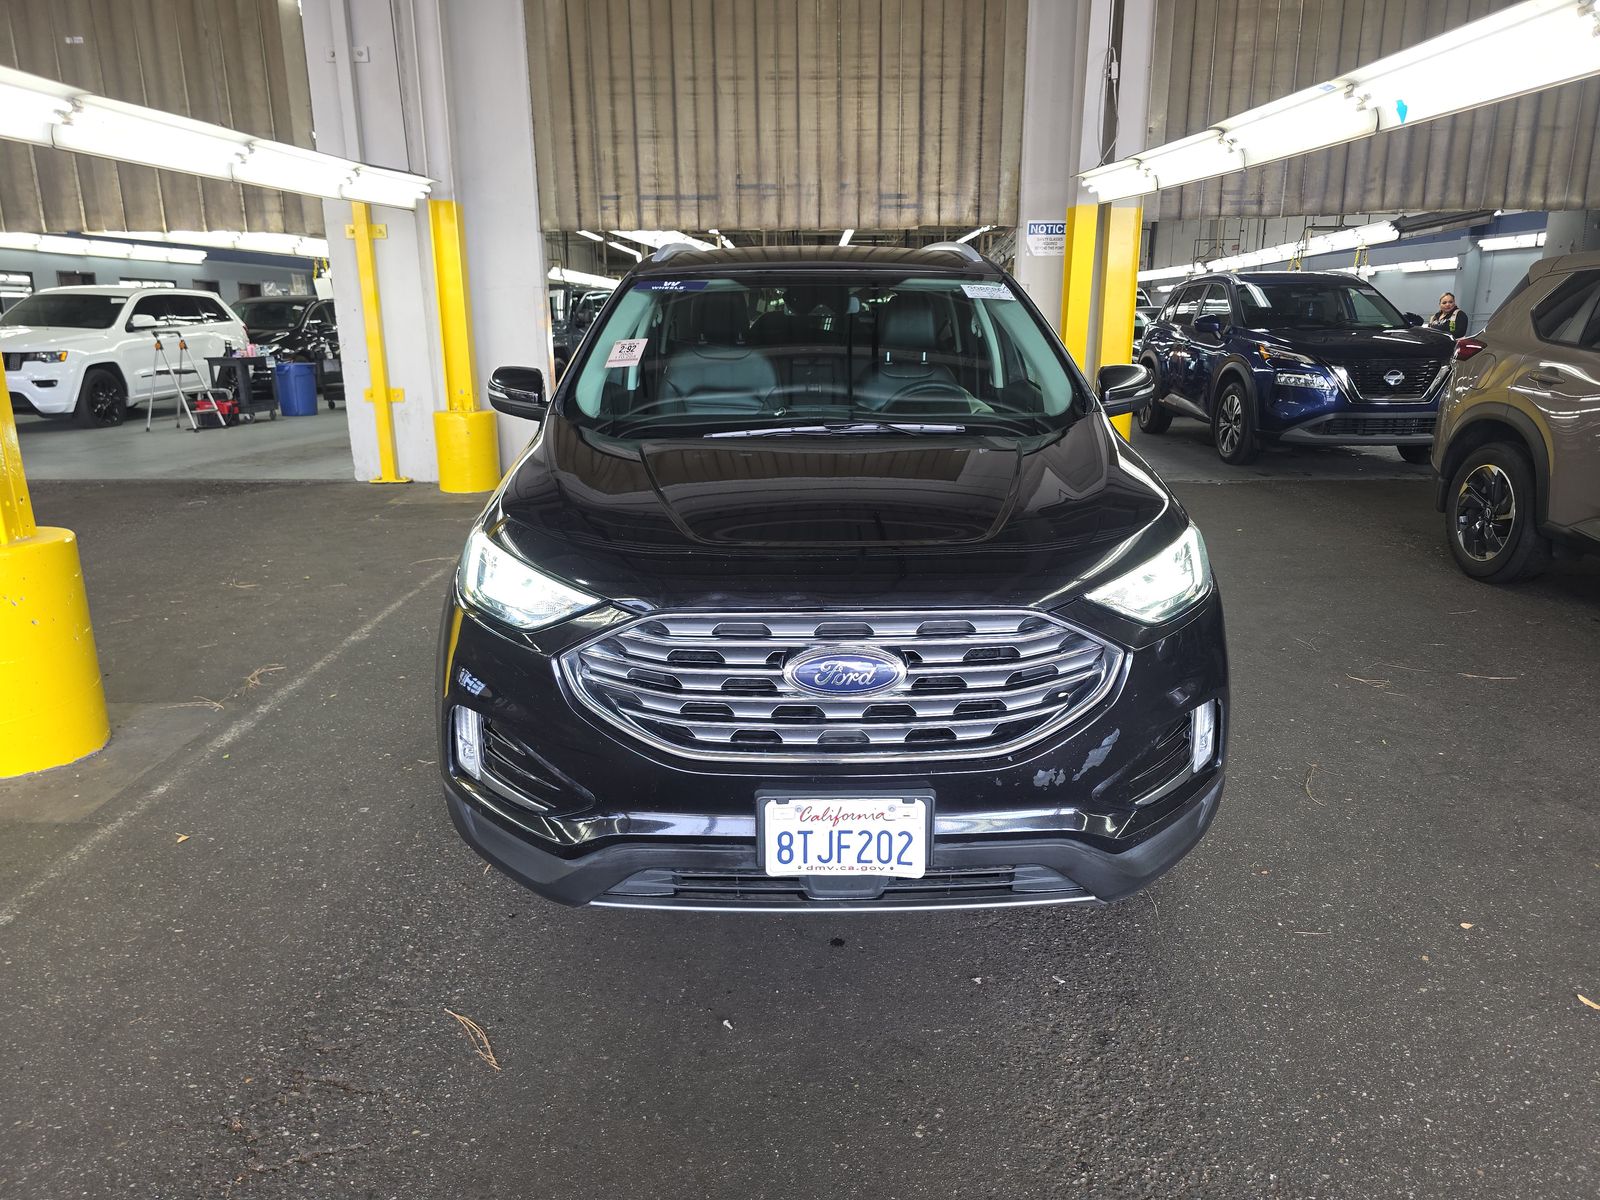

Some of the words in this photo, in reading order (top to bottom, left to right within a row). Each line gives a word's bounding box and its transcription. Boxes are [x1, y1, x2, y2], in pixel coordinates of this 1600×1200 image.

[814, 660, 877, 686] Ford
[799, 805, 896, 827] California
[776, 830, 913, 866] 8TJF202
